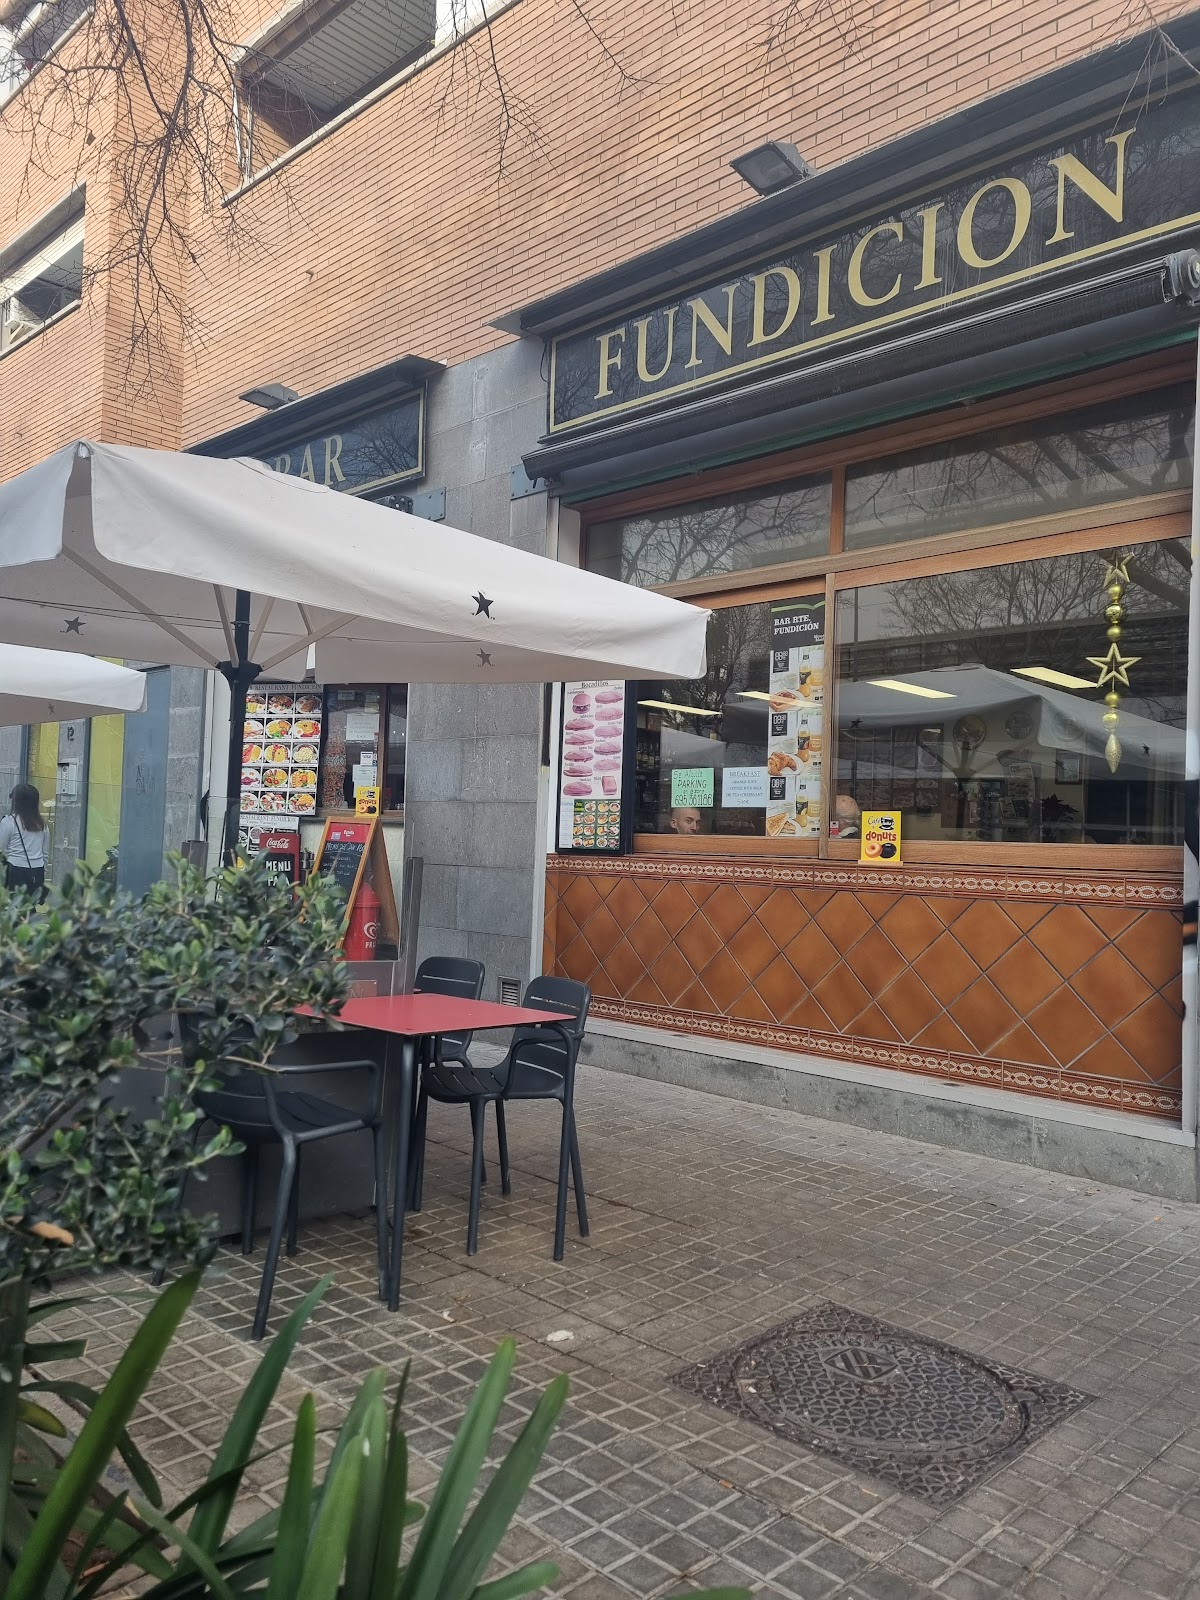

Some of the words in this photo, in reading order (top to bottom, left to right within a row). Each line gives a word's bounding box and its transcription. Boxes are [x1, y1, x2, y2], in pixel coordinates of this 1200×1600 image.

[594, 128, 1136, 399] FUNDICION
[774, 617, 791, 627] BAR
[793, 614, 811, 624] RTE.
[774, 621, 820, 636] FUNDICIÓN
[678, 780, 706, 788] PARKING
[866, 830, 897, 842] donuts
[266, 861, 291, 871] MENU
[268, 876, 289, 886] PAA
